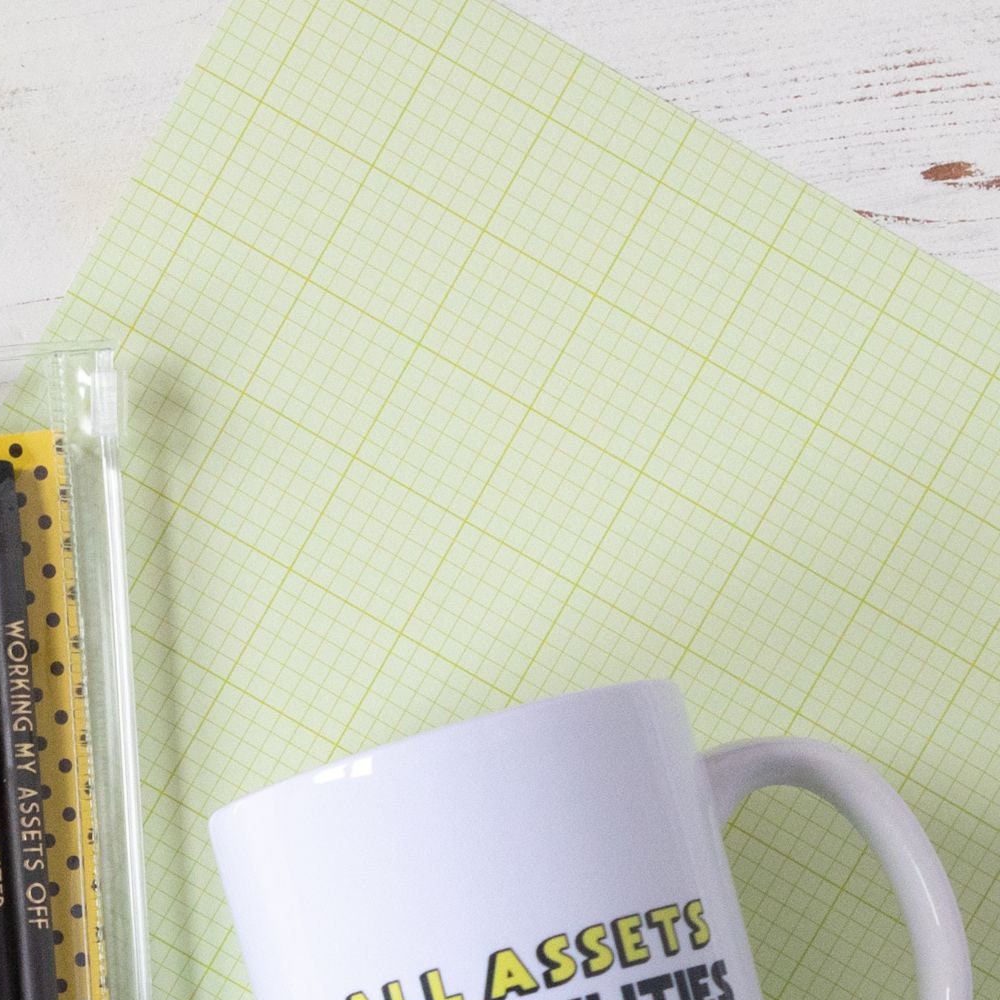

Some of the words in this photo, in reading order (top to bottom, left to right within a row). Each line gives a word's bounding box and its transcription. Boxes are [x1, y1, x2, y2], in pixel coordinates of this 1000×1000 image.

[3, 619, 33, 733] WORKING
[14, 743, 37, 775] MY
[17, 786, 45, 871] ASSETS
[25, 882, 49, 930] OFF
